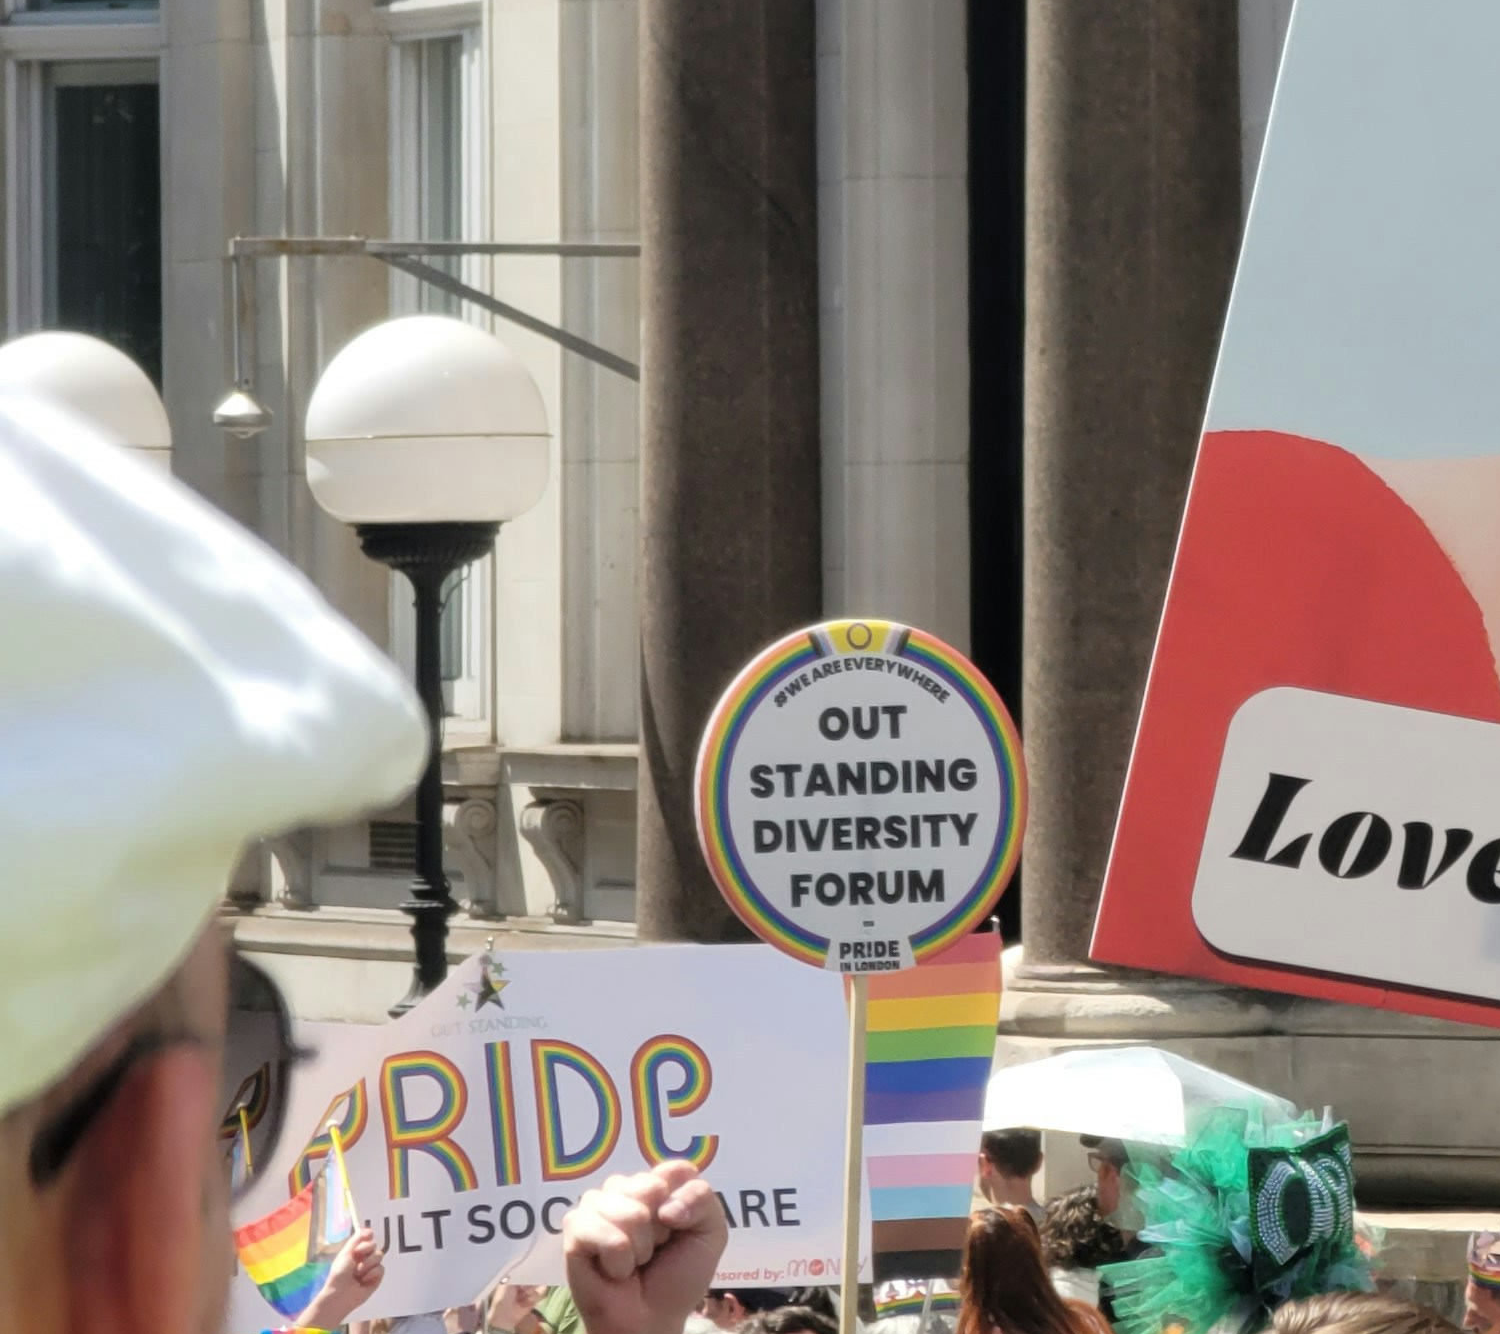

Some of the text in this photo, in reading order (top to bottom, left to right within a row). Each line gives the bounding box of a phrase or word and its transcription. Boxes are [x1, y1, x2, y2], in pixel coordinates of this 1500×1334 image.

[818, 705, 907, 741] OUT
[750, 758, 977, 798] STANDING
[753, 813, 978, 854] DIVERSITY
[790, 869, 944, 908] FORUM
[839, 960, 900, 972] IN LONDON
[764, 1267, 785, 1282] by:
